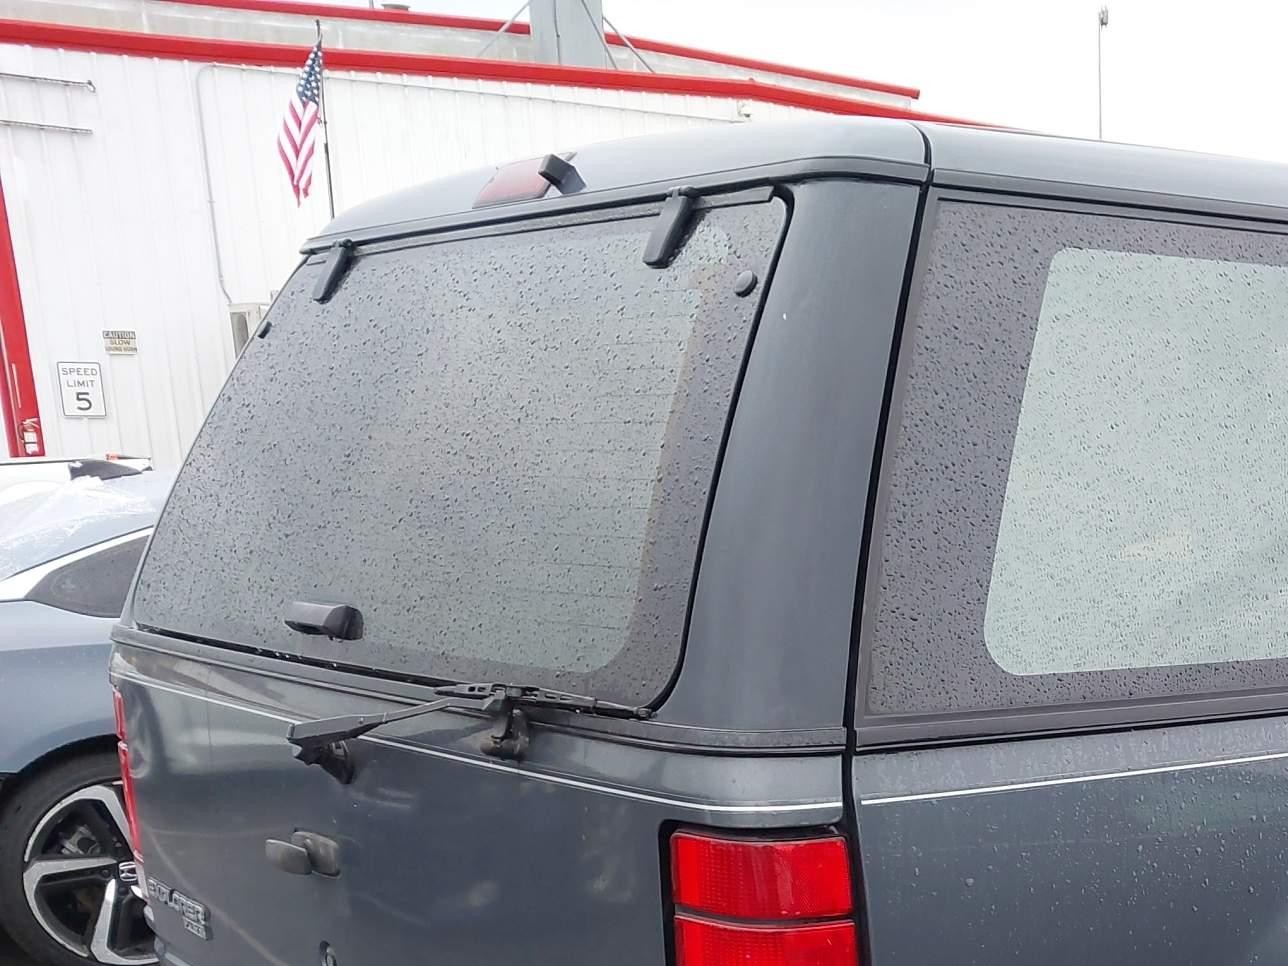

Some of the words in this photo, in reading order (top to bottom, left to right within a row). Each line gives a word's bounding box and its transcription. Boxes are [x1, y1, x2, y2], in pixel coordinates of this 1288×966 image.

[61, 367, 98, 376] SPEED
[66, 379, 96, 388] LIMIT
[76, 391, 93, 411] 5
